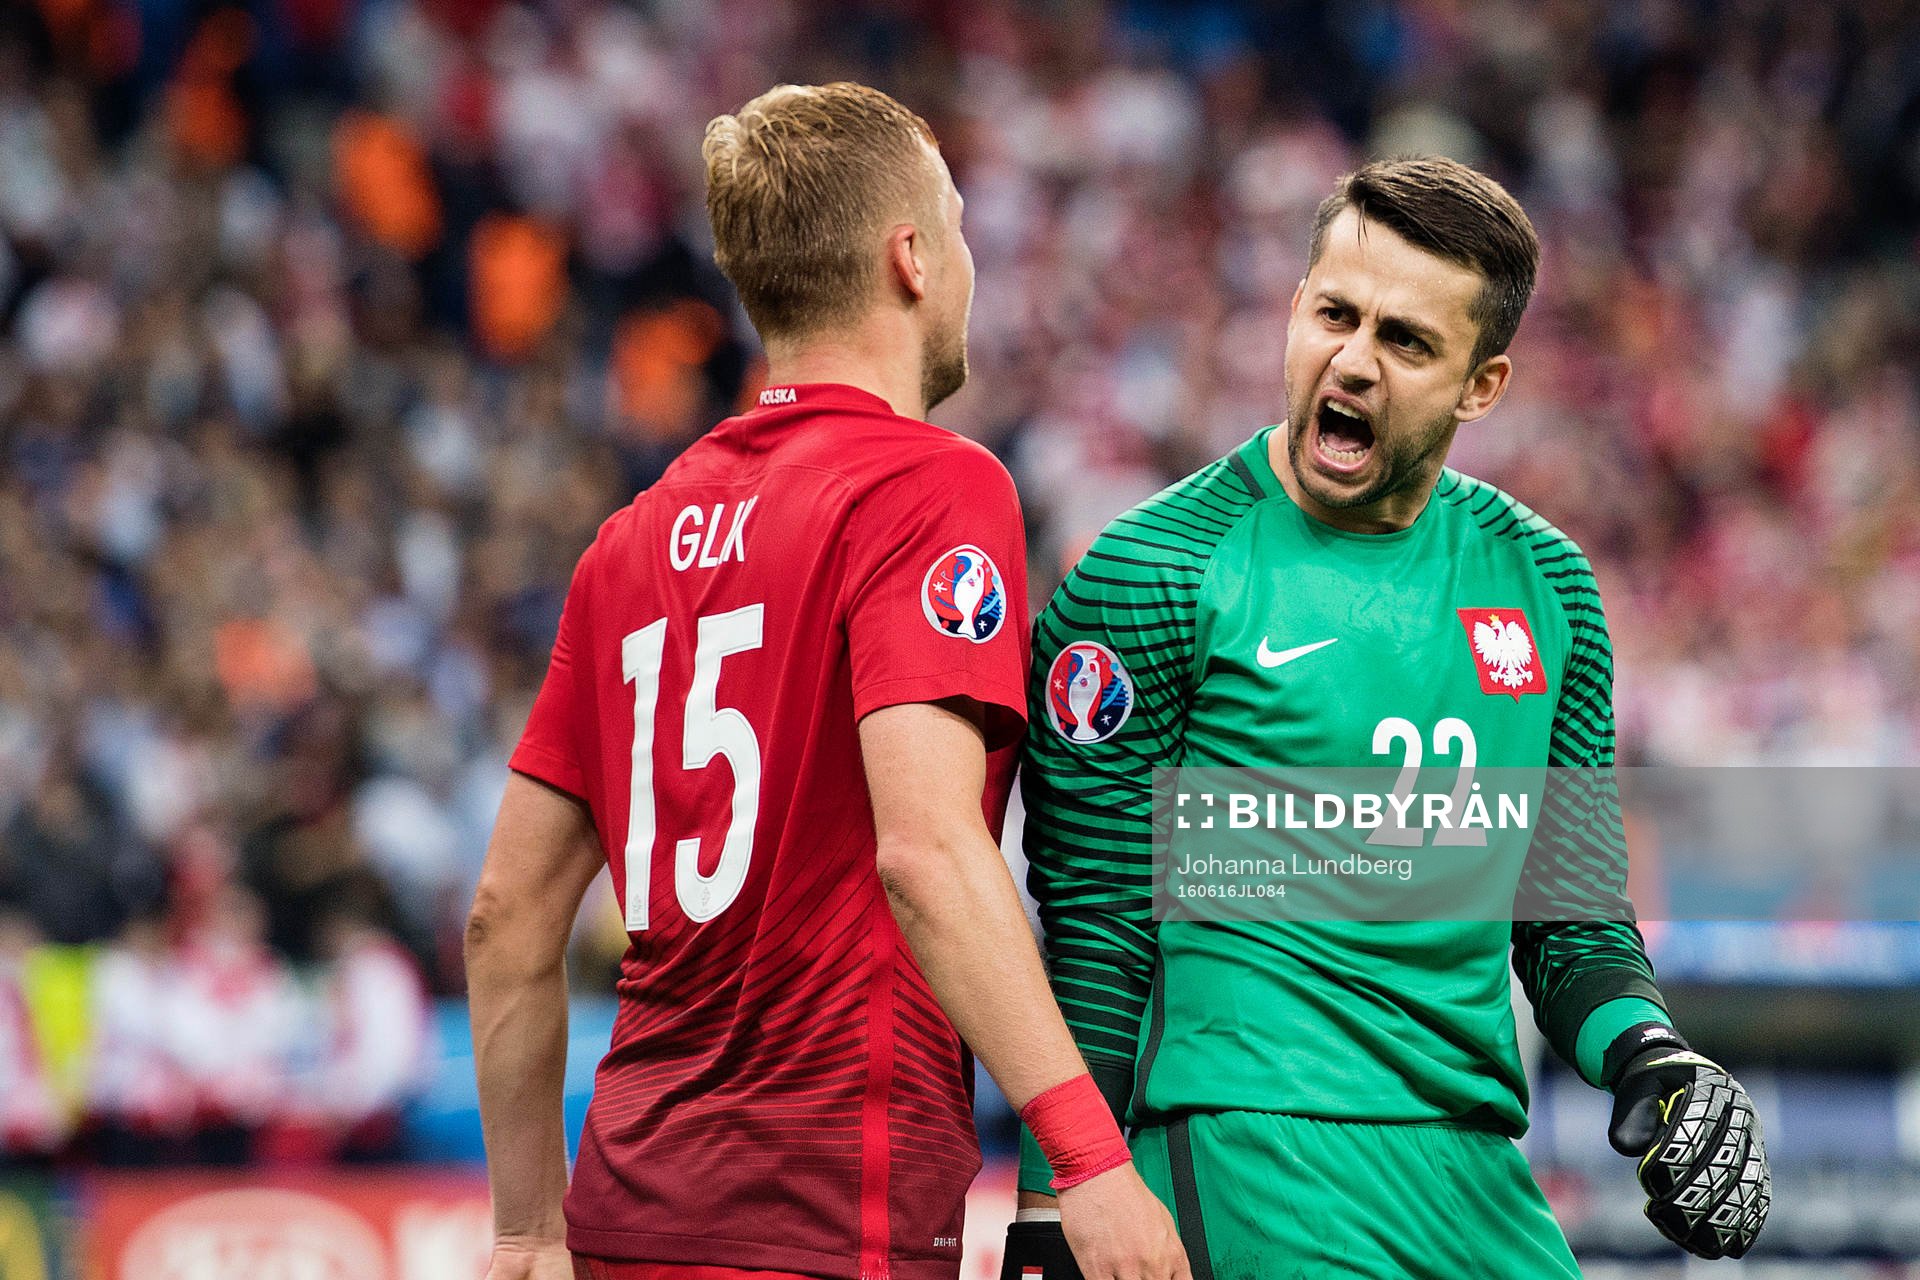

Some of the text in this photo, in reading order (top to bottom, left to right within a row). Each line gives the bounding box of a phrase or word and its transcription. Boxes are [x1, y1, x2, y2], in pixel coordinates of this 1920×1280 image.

[759, 387, 797, 406] POLSKA
[622, 603, 765, 932] 15
[1364, 717, 1488, 847] 22
[933, 1237, 957, 1247] DRI-FIT
